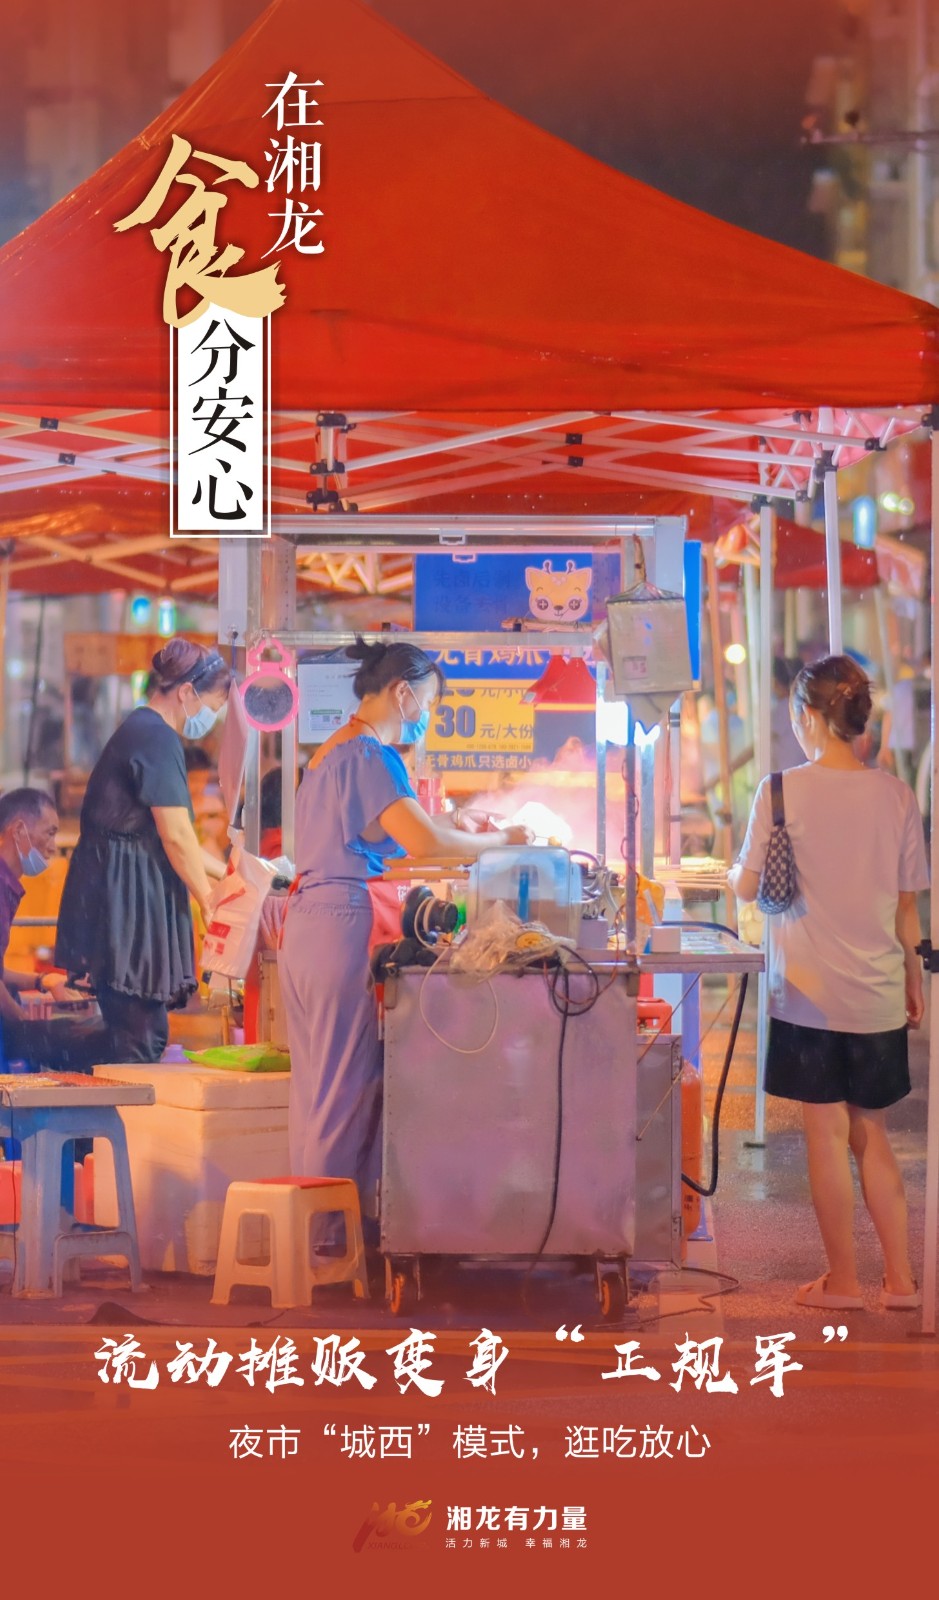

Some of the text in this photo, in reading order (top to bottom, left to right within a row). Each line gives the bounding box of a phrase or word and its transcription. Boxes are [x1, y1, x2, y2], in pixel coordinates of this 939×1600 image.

[435, 705, 533, 741] 30 元/大份
